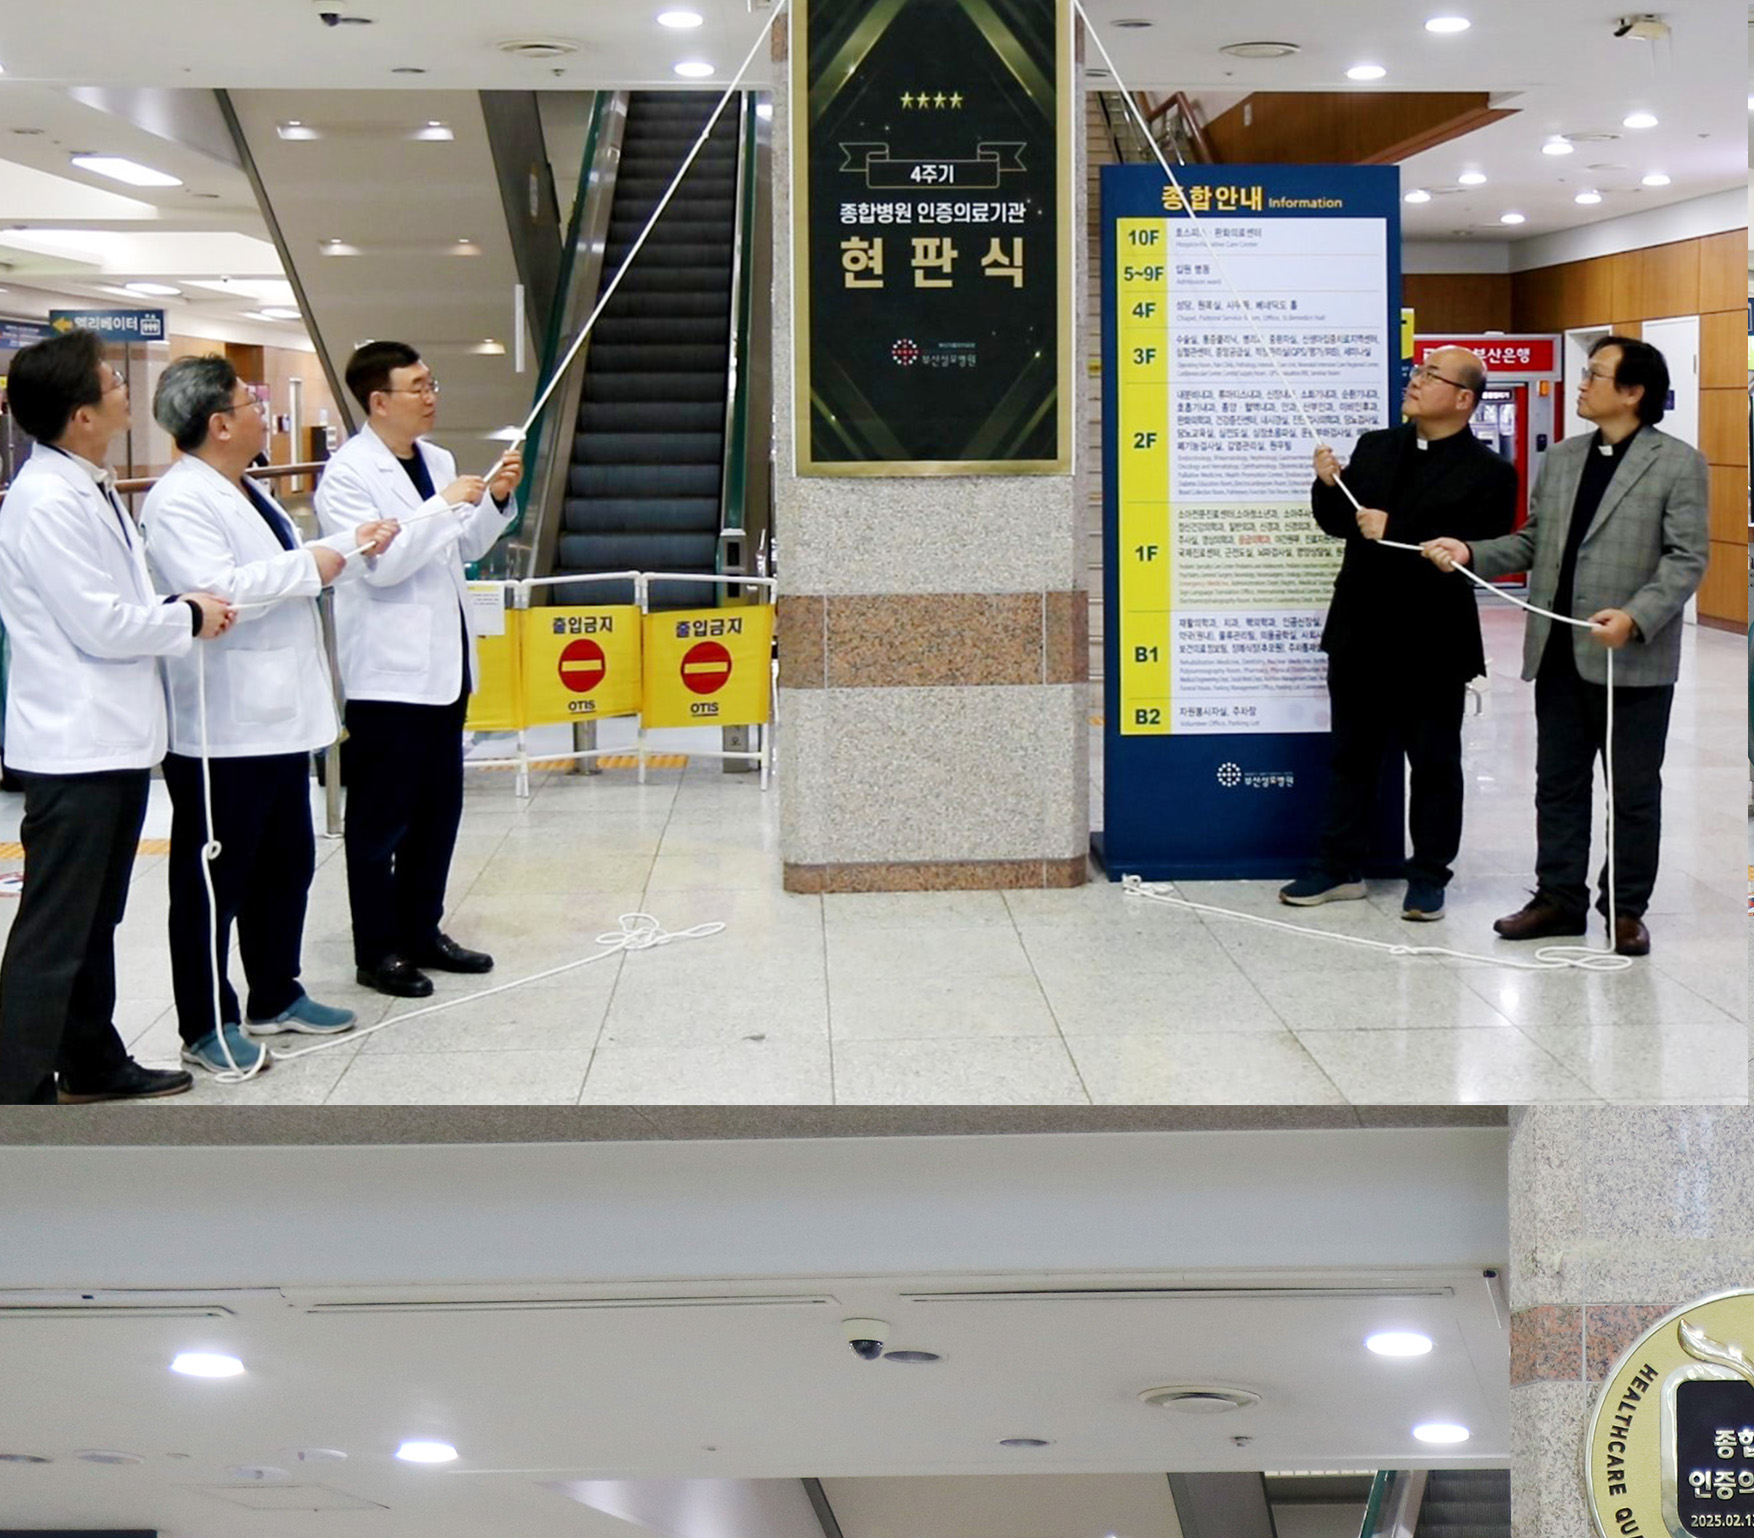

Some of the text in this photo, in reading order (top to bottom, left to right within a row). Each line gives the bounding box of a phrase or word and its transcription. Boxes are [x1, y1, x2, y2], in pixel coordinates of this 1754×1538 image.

[910, 165, 954, 184] 4주기
[1161, 185, 1343, 211] 종합안내 Information
[840, 203, 1026, 223] 종합병원 인증의료기관
[1128, 230, 1159, 246] 10F
[1124, 266, 1165, 281] 5~9F
[1133, 303, 1156, 318] 4F
[1133, 348, 1157, 365] 3F
[1134, 433, 1158, 449] 2F
[1135, 546, 1158, 562] 1F
[552, 615, 613, 634] 출입금지
[676, 617, 743, 638] 출입금지
[1135, 646, 1159, 663] B1
[568, 700, 595, 711] OTIS
[690, 702, 719, 713] OTIS
[1135, 708, 1161, 725] B2
[1607, 1363, 1659, 1496] HEALTHCARE
